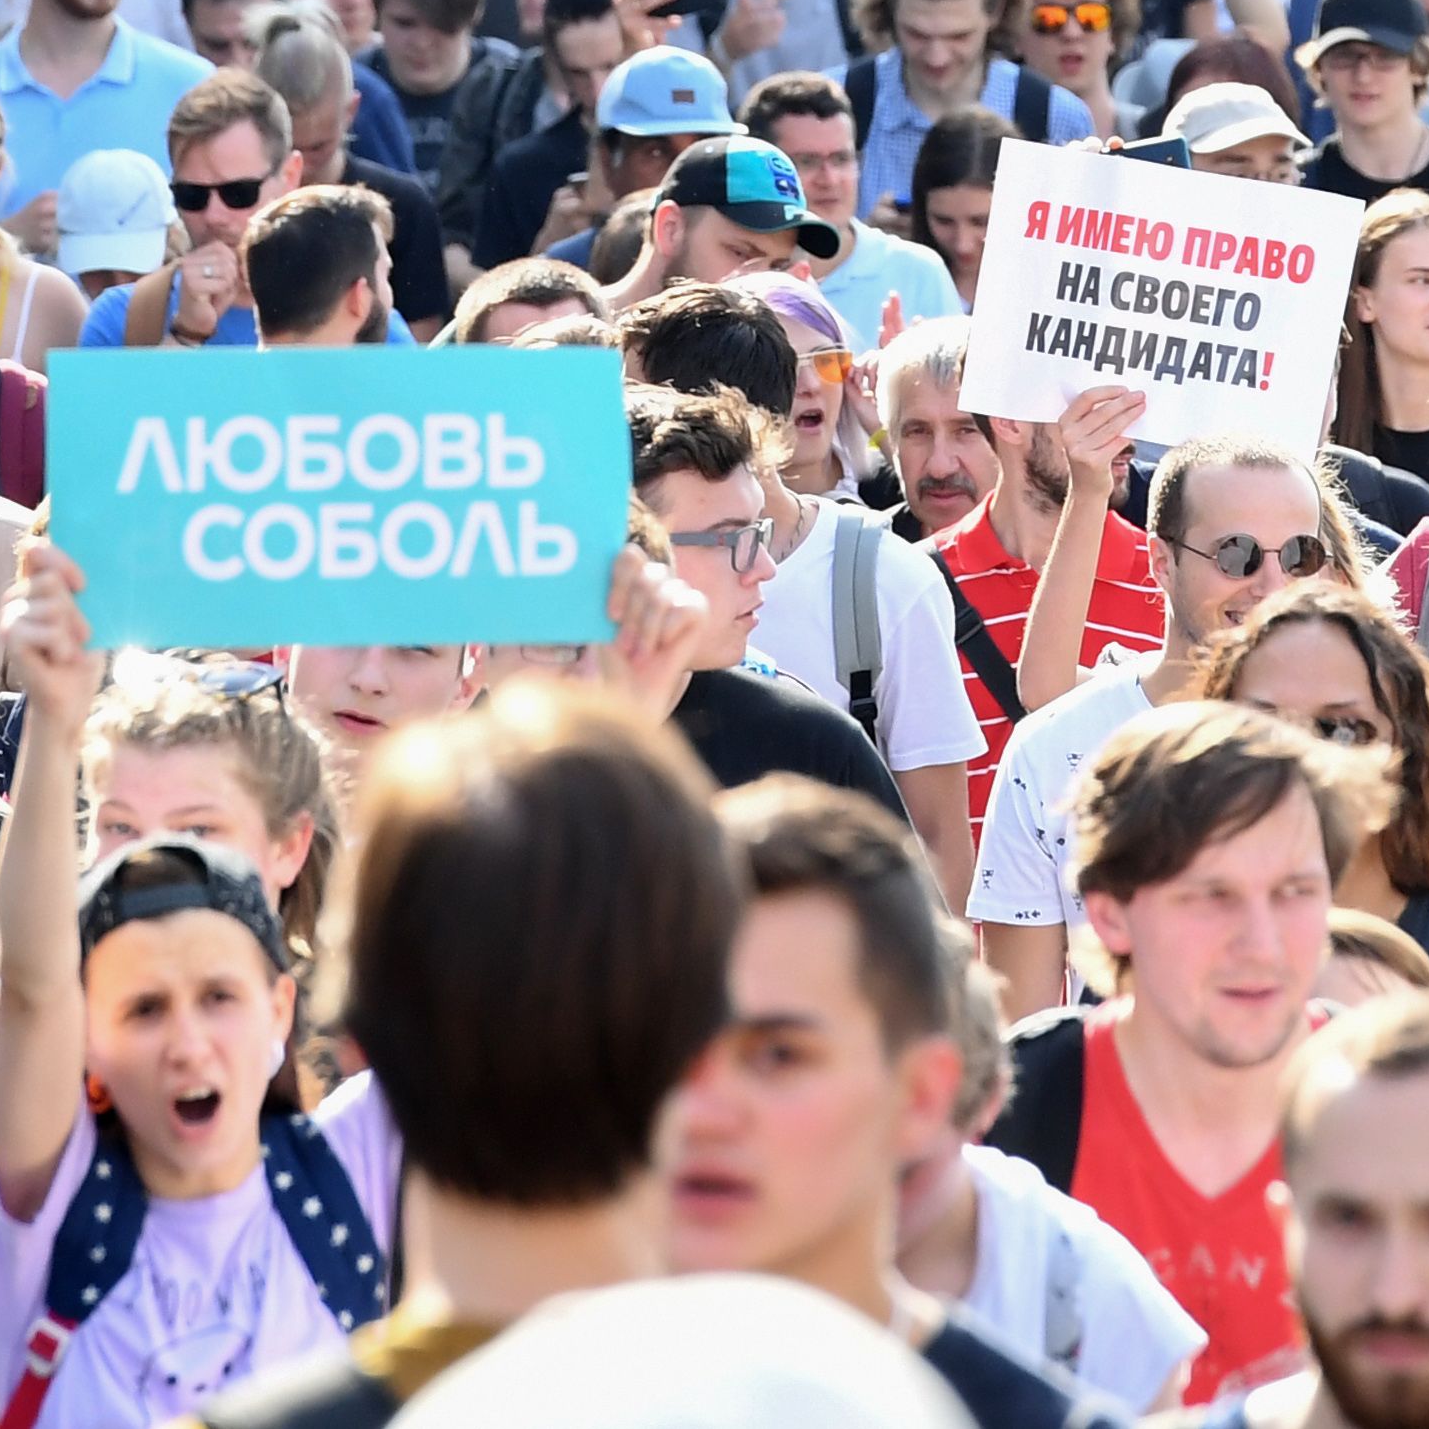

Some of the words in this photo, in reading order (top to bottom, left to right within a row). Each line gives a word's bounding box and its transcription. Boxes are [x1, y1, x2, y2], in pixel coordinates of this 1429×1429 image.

[1024, 200, 1050, 240] Я
[1055, 204, 1174, 261] ИМЕЮ
[1182, 227, 1315, 284] ПРАВО
[1056, 261, 1100, 306] НА
[1110, 270, 1261, 332] СВОЕГО
[1025, 312, 1275, 391] КАНДИДАТА!
[118, 414, 545, 492] ЛЮБОВЬ
[183, 502, 577, 580] СОБОЛЬ
